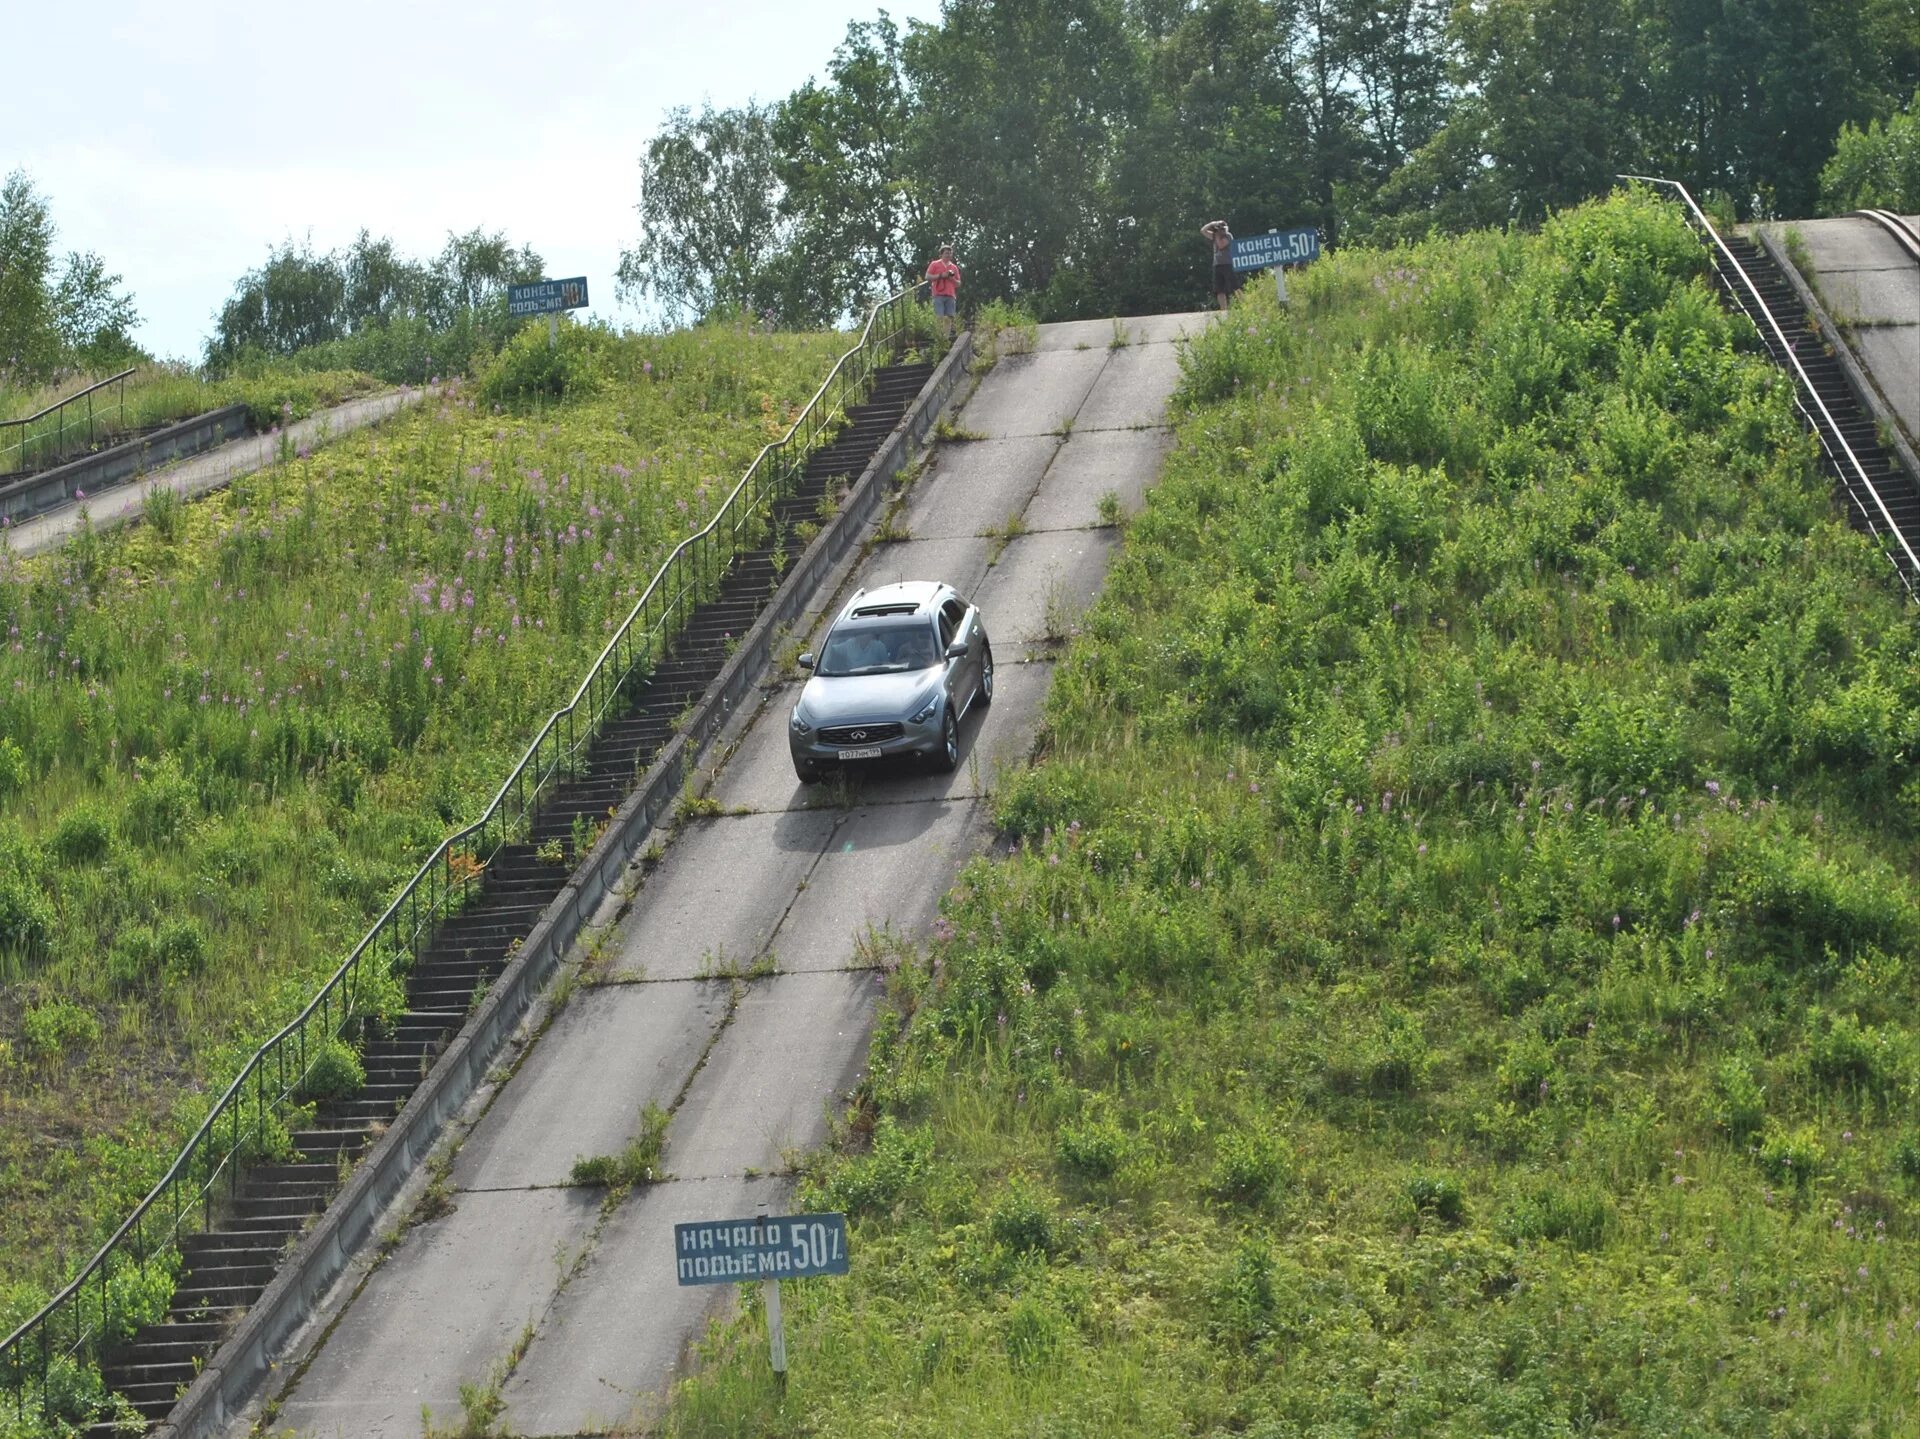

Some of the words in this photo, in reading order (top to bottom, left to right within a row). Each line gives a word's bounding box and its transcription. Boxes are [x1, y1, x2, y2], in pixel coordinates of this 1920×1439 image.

[1237, 236, 1282, 253] КОНЕЦ
[515, 284, 555, 300] КОНЕЦ
[681, 1224, 781, 1250] НАЧАЛО
[791, 1222, 843, 1269] 50%
